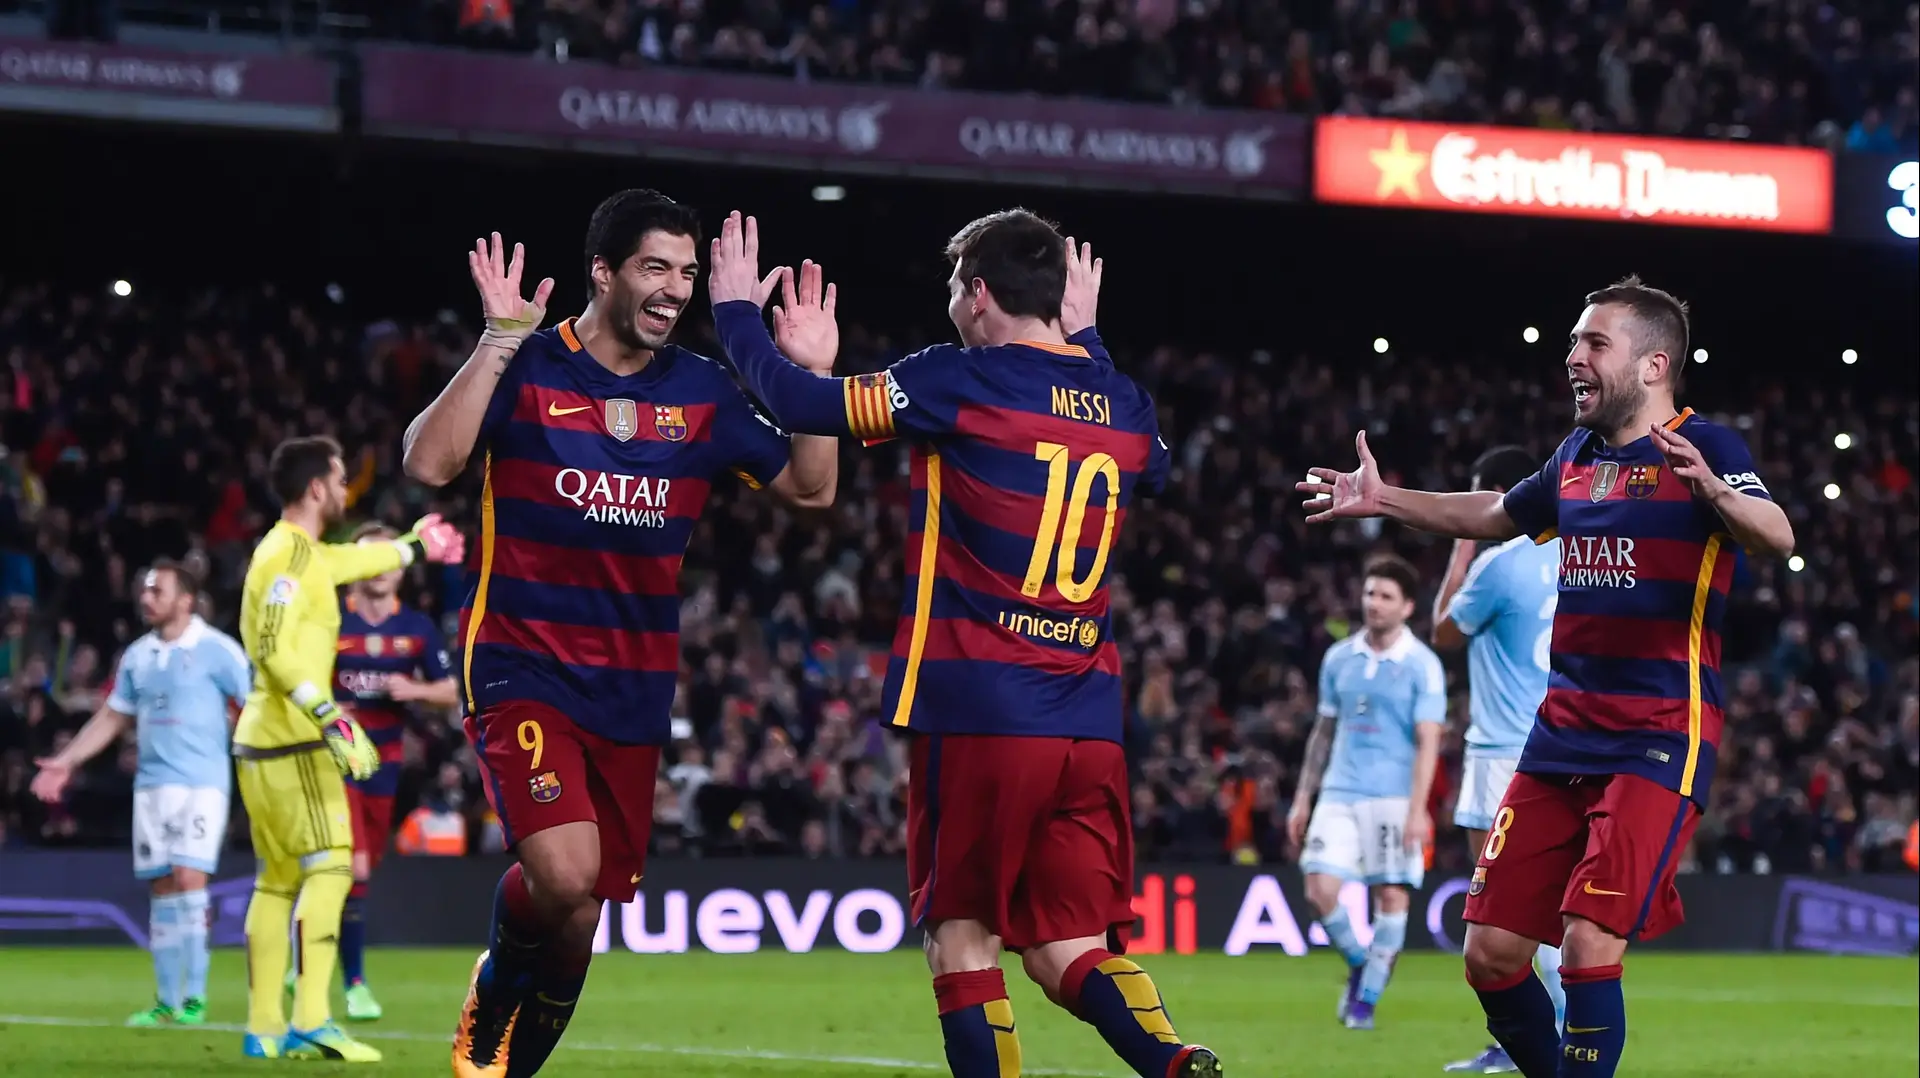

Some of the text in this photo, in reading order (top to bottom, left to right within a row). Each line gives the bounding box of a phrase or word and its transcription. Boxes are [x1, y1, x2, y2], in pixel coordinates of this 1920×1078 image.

[558, 86, 832, 142] QATAR AIRWAYS
[958, 116, 1220, 171] QATAR AIRWAYS
[1431, 132, 1778, 222] Estrella Damm
[1051, 385, 1111, 426] MESSI
[555, 468, 670, 507] QATAR
[583, 503, 665, 529] AIRWAYS
[1020, 441, 1120, 603] 10
[1564, 568, 1636, 589] AIRWAYS
[998, 611, 1081, 643] unicef
[517, 720, 543, 770] 9
[1485, 806, 1514, 860] 8
[1564, 1044, 1599, 1062] FCB
